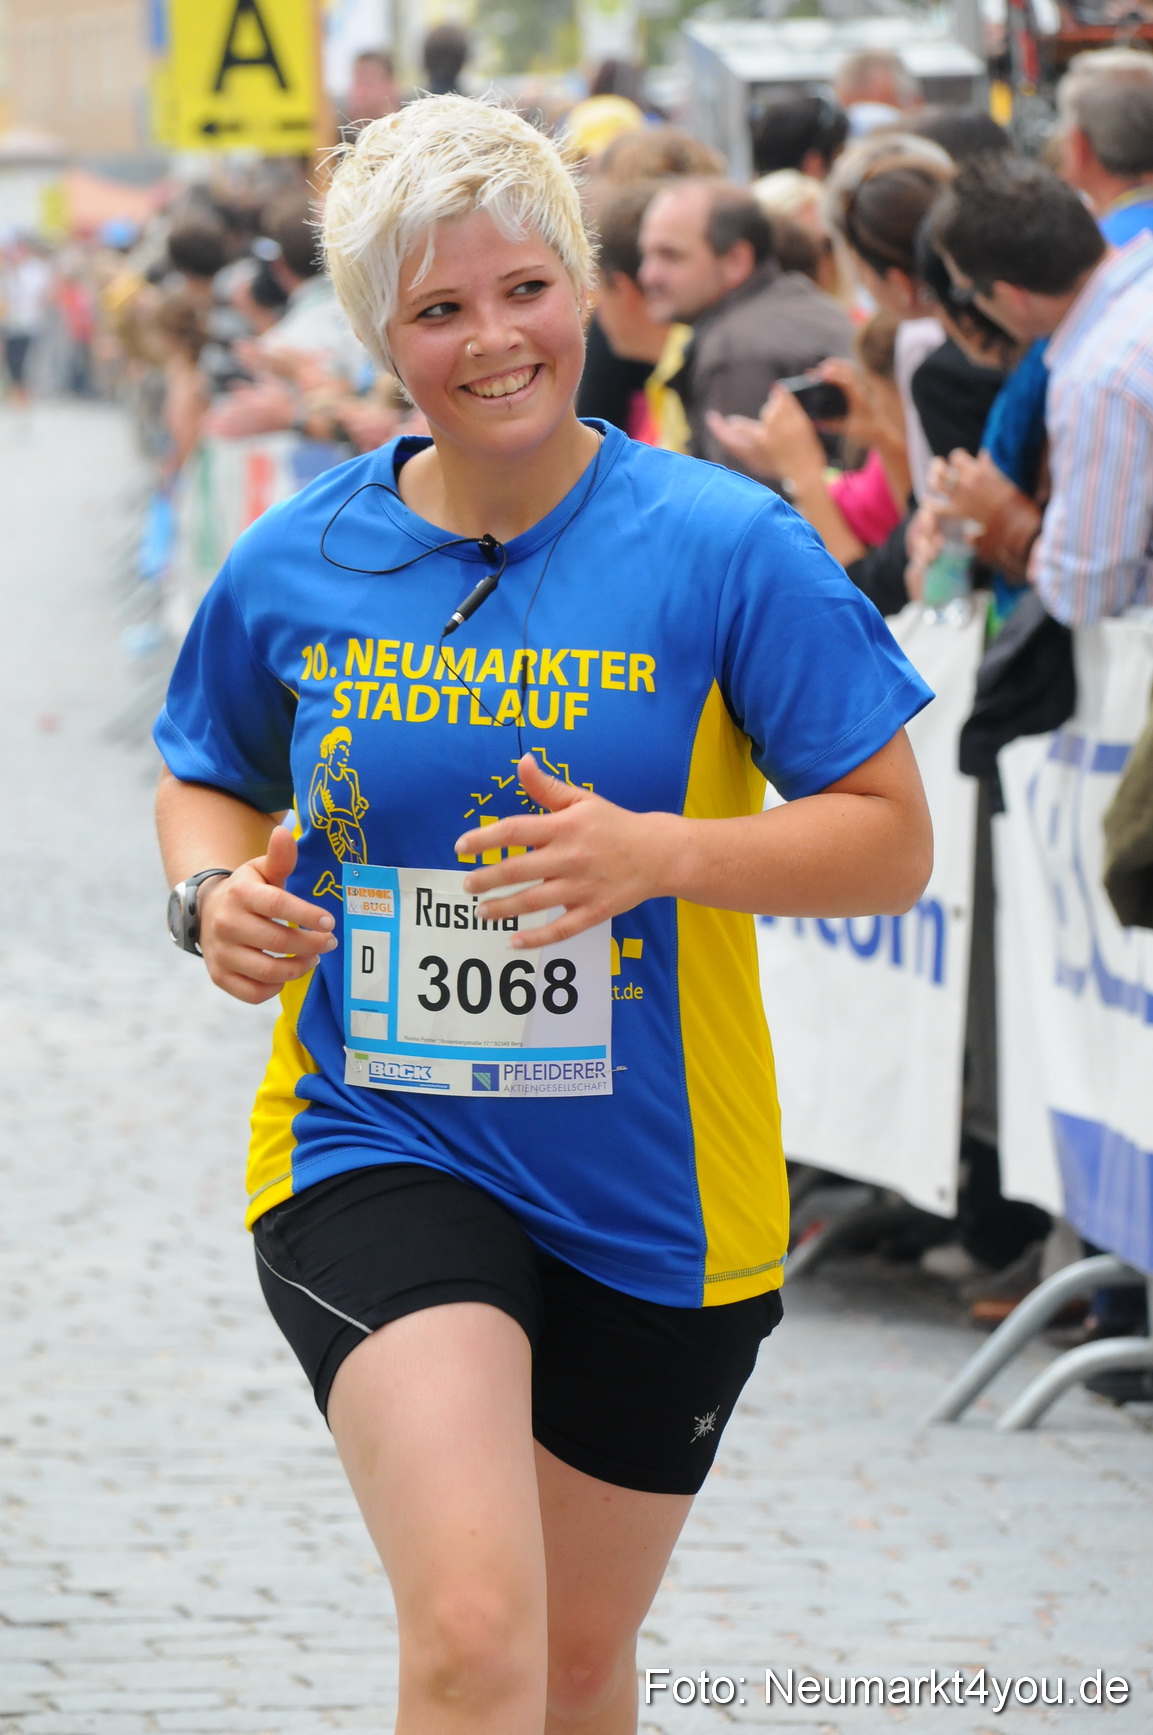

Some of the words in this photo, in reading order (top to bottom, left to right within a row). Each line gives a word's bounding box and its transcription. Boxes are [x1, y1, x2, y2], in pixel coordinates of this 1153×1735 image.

[212, 0, 289, 93] A
[345, 638, 657, 693] NEUMARKTER
[331, 681, 589, 731] STADTLAUF
[362, 945, 375, 974] D
[417, 955, 579, 1016] 3068
[610, 982, 644, 1001] t.de
[369, 1061, 432, 1081] BOCK
[503, 1061, 607, 1081] PFLEIDERER
[503, 1081, 608, 1093] AKTIENGESELLSCHAFT
